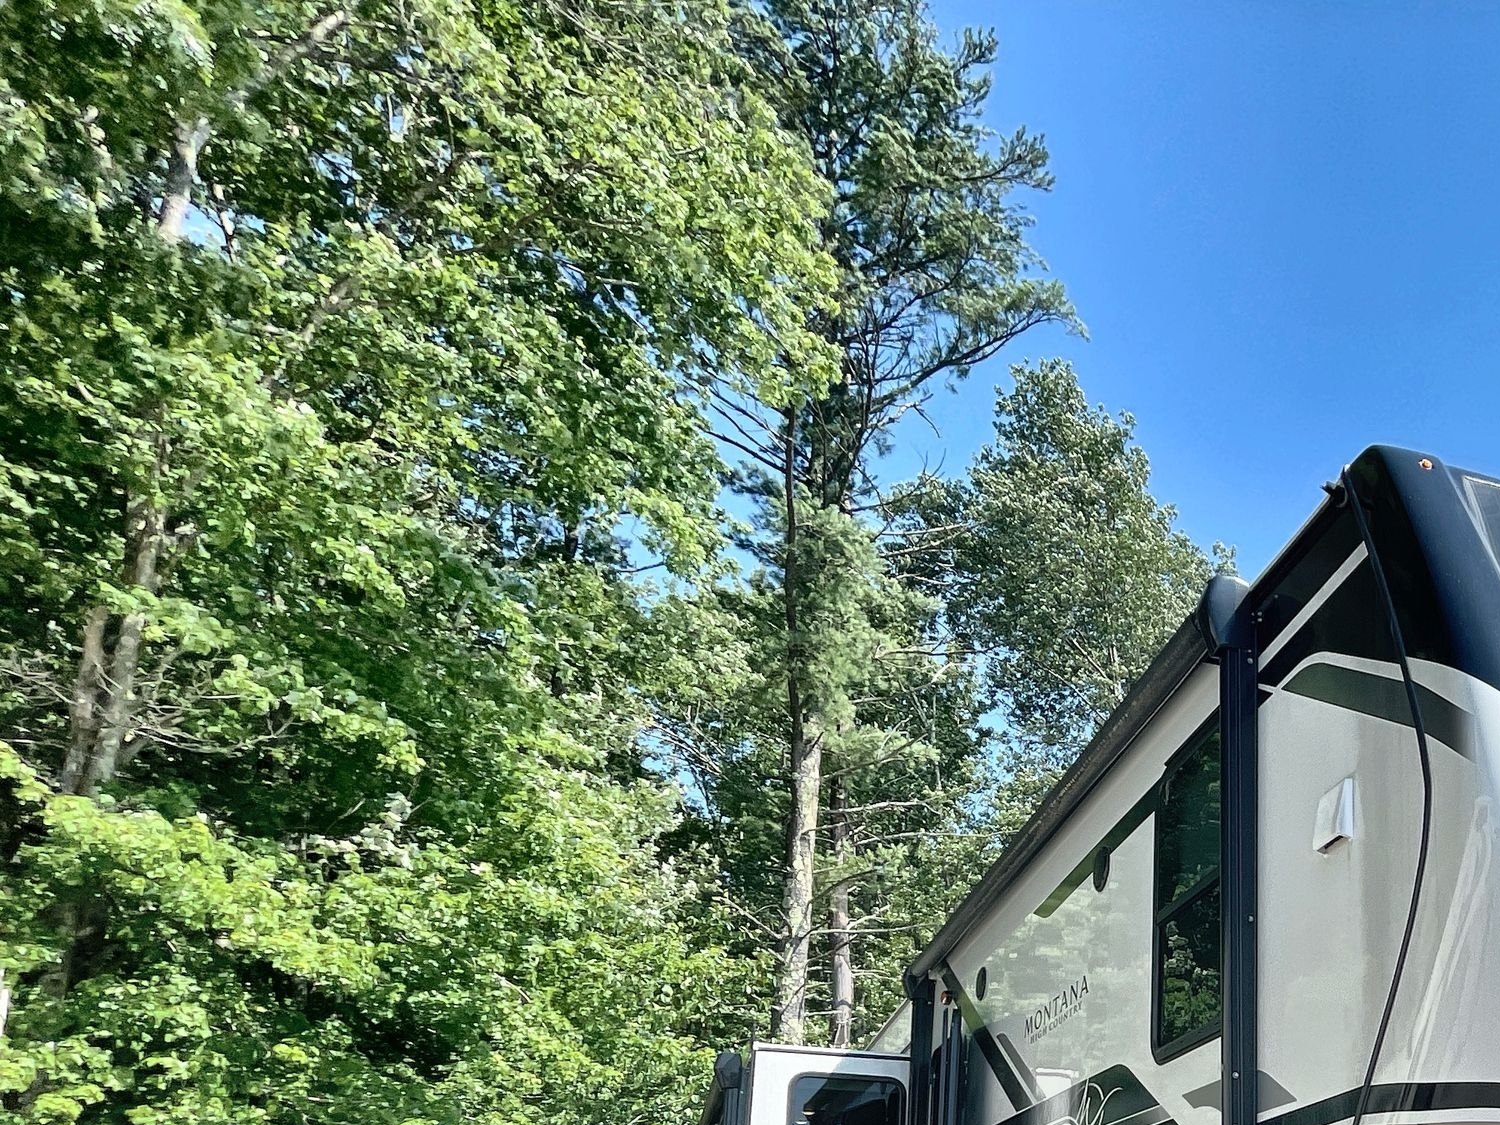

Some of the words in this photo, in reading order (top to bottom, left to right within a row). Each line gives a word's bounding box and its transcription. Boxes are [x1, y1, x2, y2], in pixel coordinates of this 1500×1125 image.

[1024, 975, 1089, 1039] MONTANA
[1030, 1025, 1048, 1045] HIGH
[1048, 1000, 1083, 1032] COUNTRY
